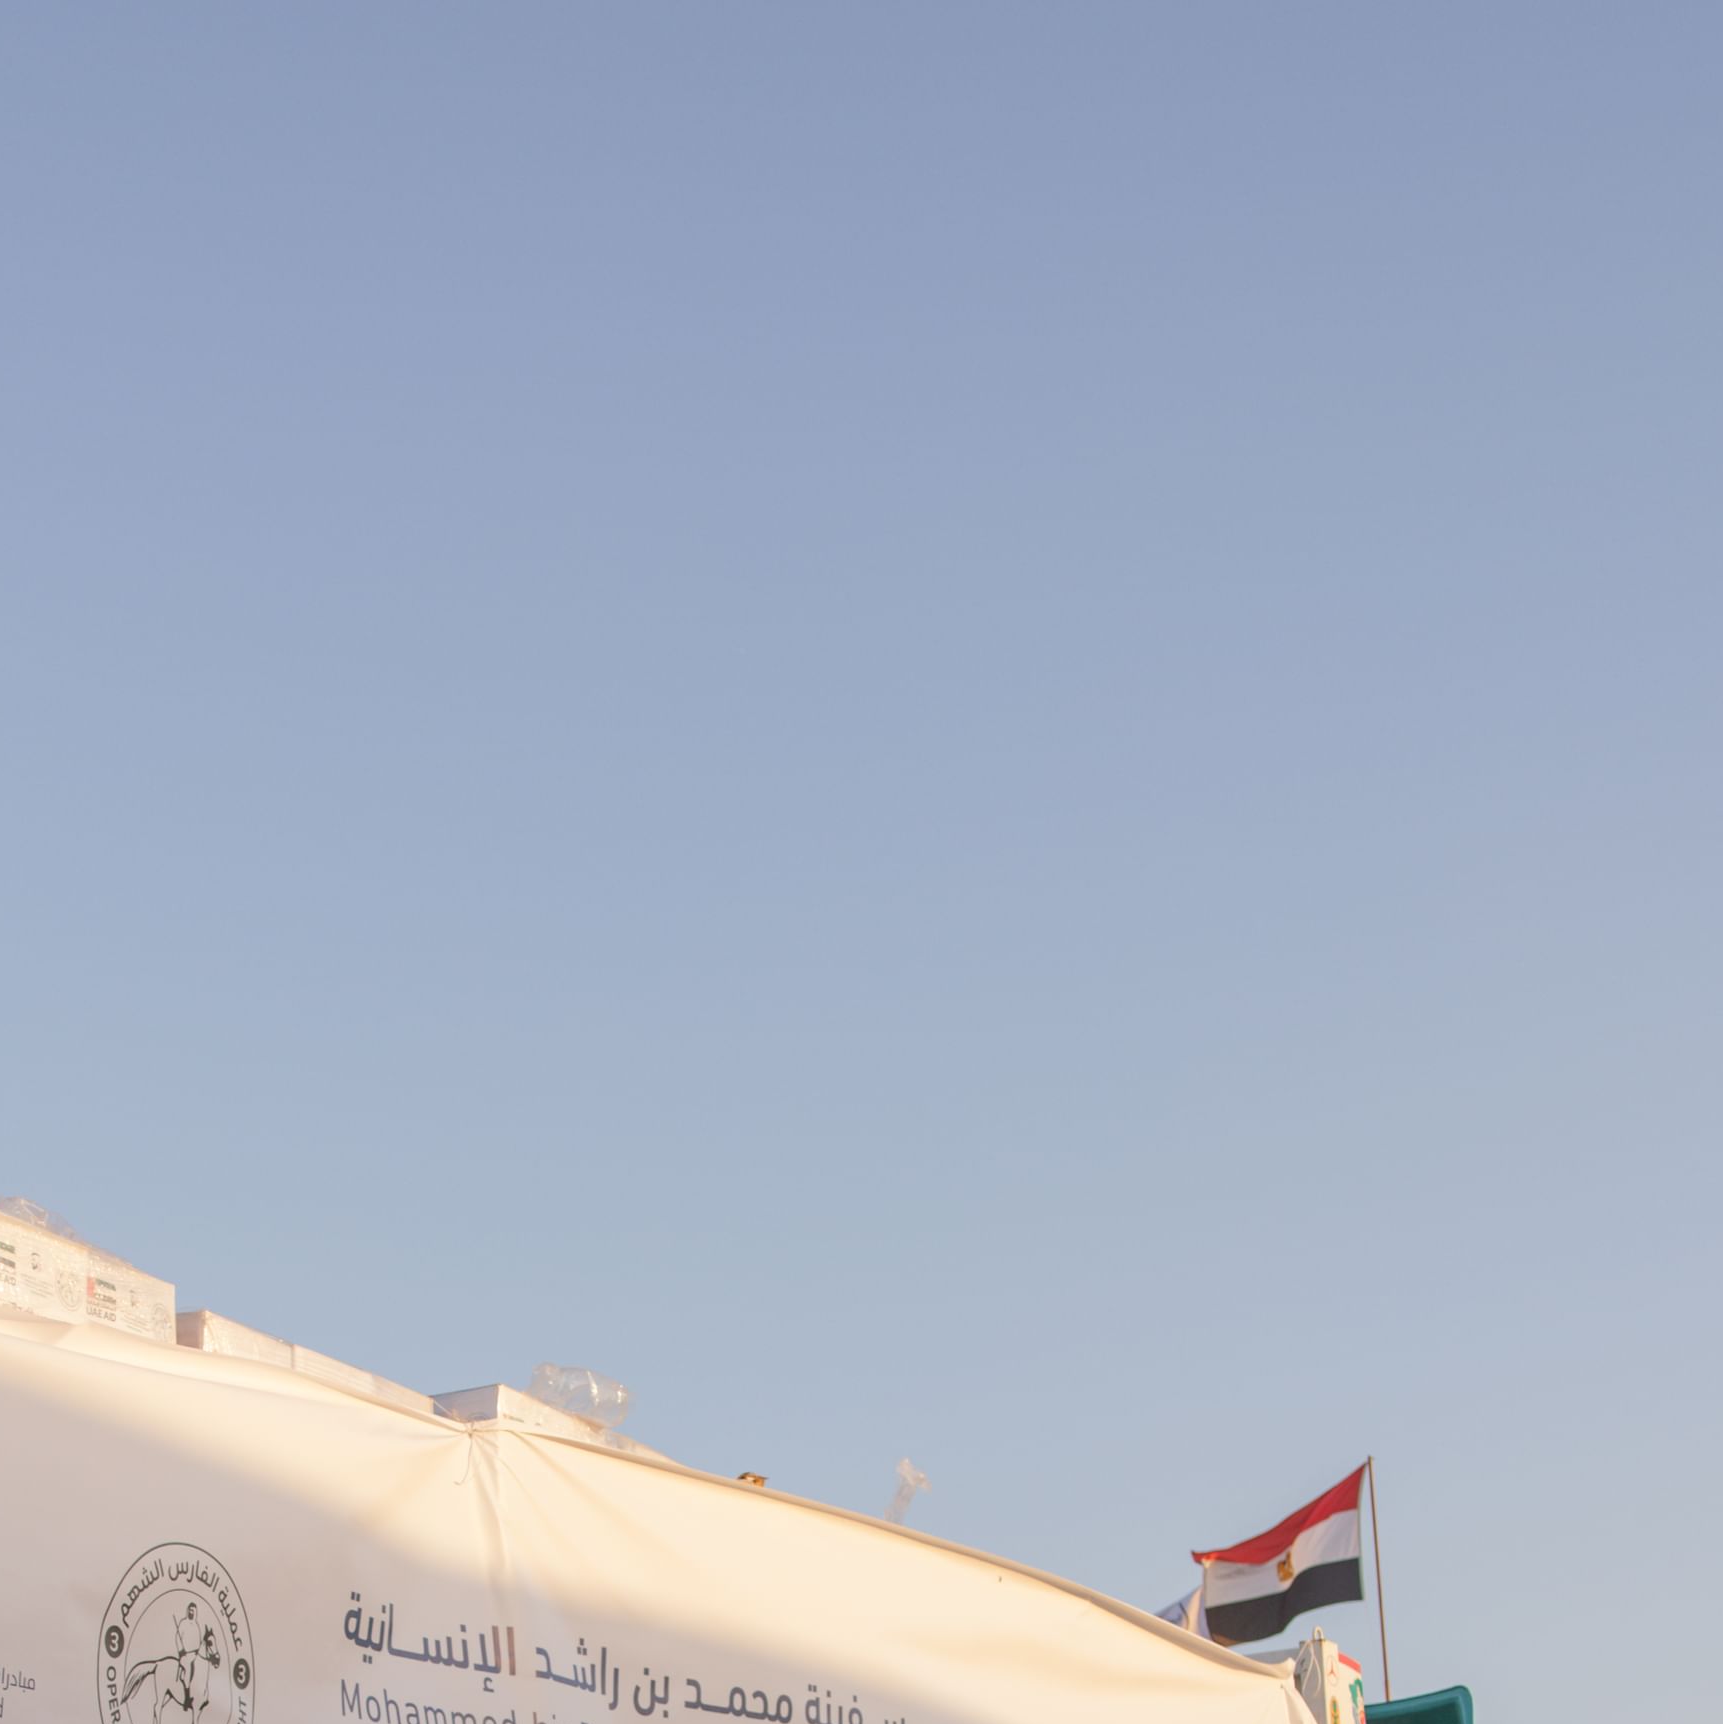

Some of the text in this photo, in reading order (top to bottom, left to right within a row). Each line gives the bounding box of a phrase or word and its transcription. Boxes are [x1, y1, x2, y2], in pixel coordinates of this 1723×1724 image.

[86, 1305, 117, 1323] UAE AID
[120, 1558, 243, 1652] عملية الفارس الشهم
[343, 1591, 517, 1693] الإنسانية
[535, 1637, 620, 1711] راشد
[633, 1667, 669, 1719] بن
[684, 1678, 793, 1724] محمد
